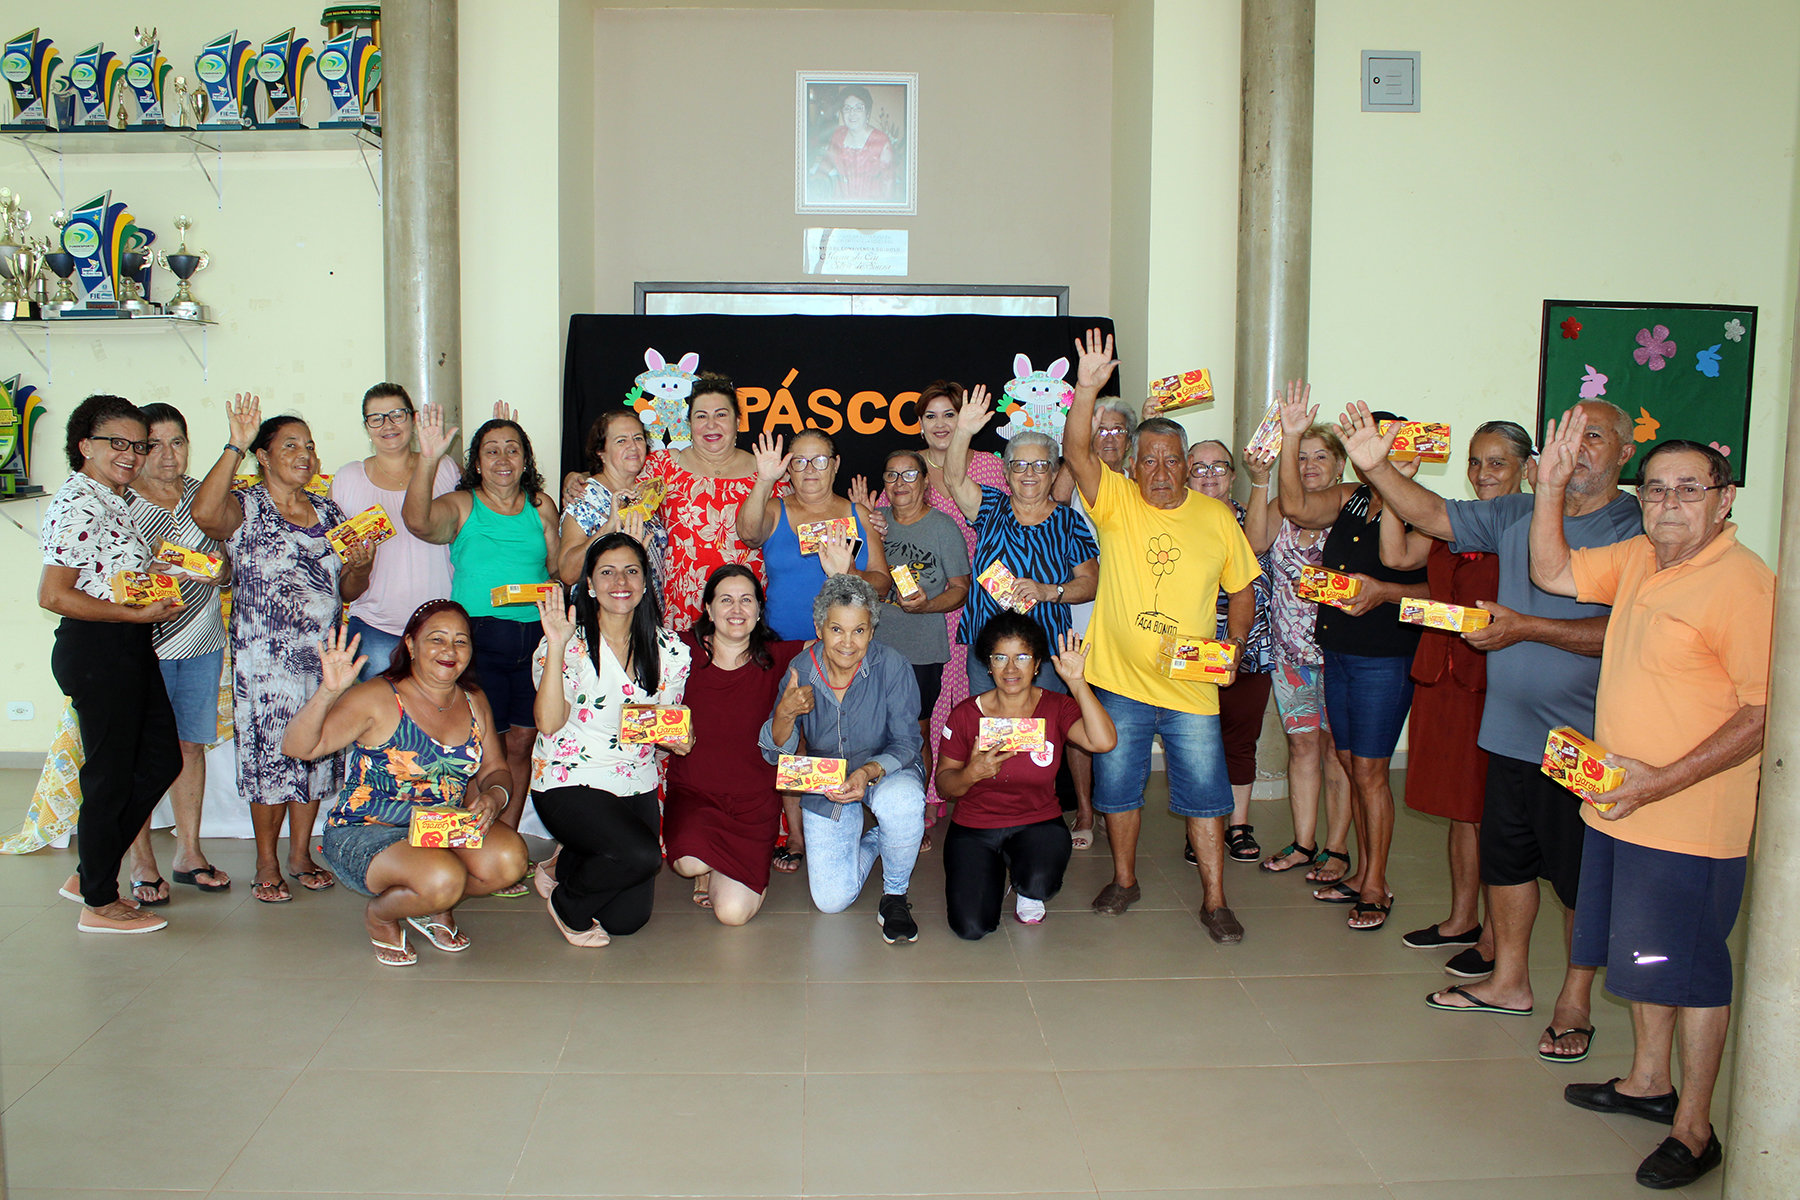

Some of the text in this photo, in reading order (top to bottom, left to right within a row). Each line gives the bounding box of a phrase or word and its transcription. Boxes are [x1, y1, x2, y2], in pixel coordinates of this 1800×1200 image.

[1134, 613, 1178, 636] FAÇA BONITO
[656, 725, 683, 736] Garoto
[1575, 772, 1601, 794] Garoto
[421, 820, 450, 832] Garoto
